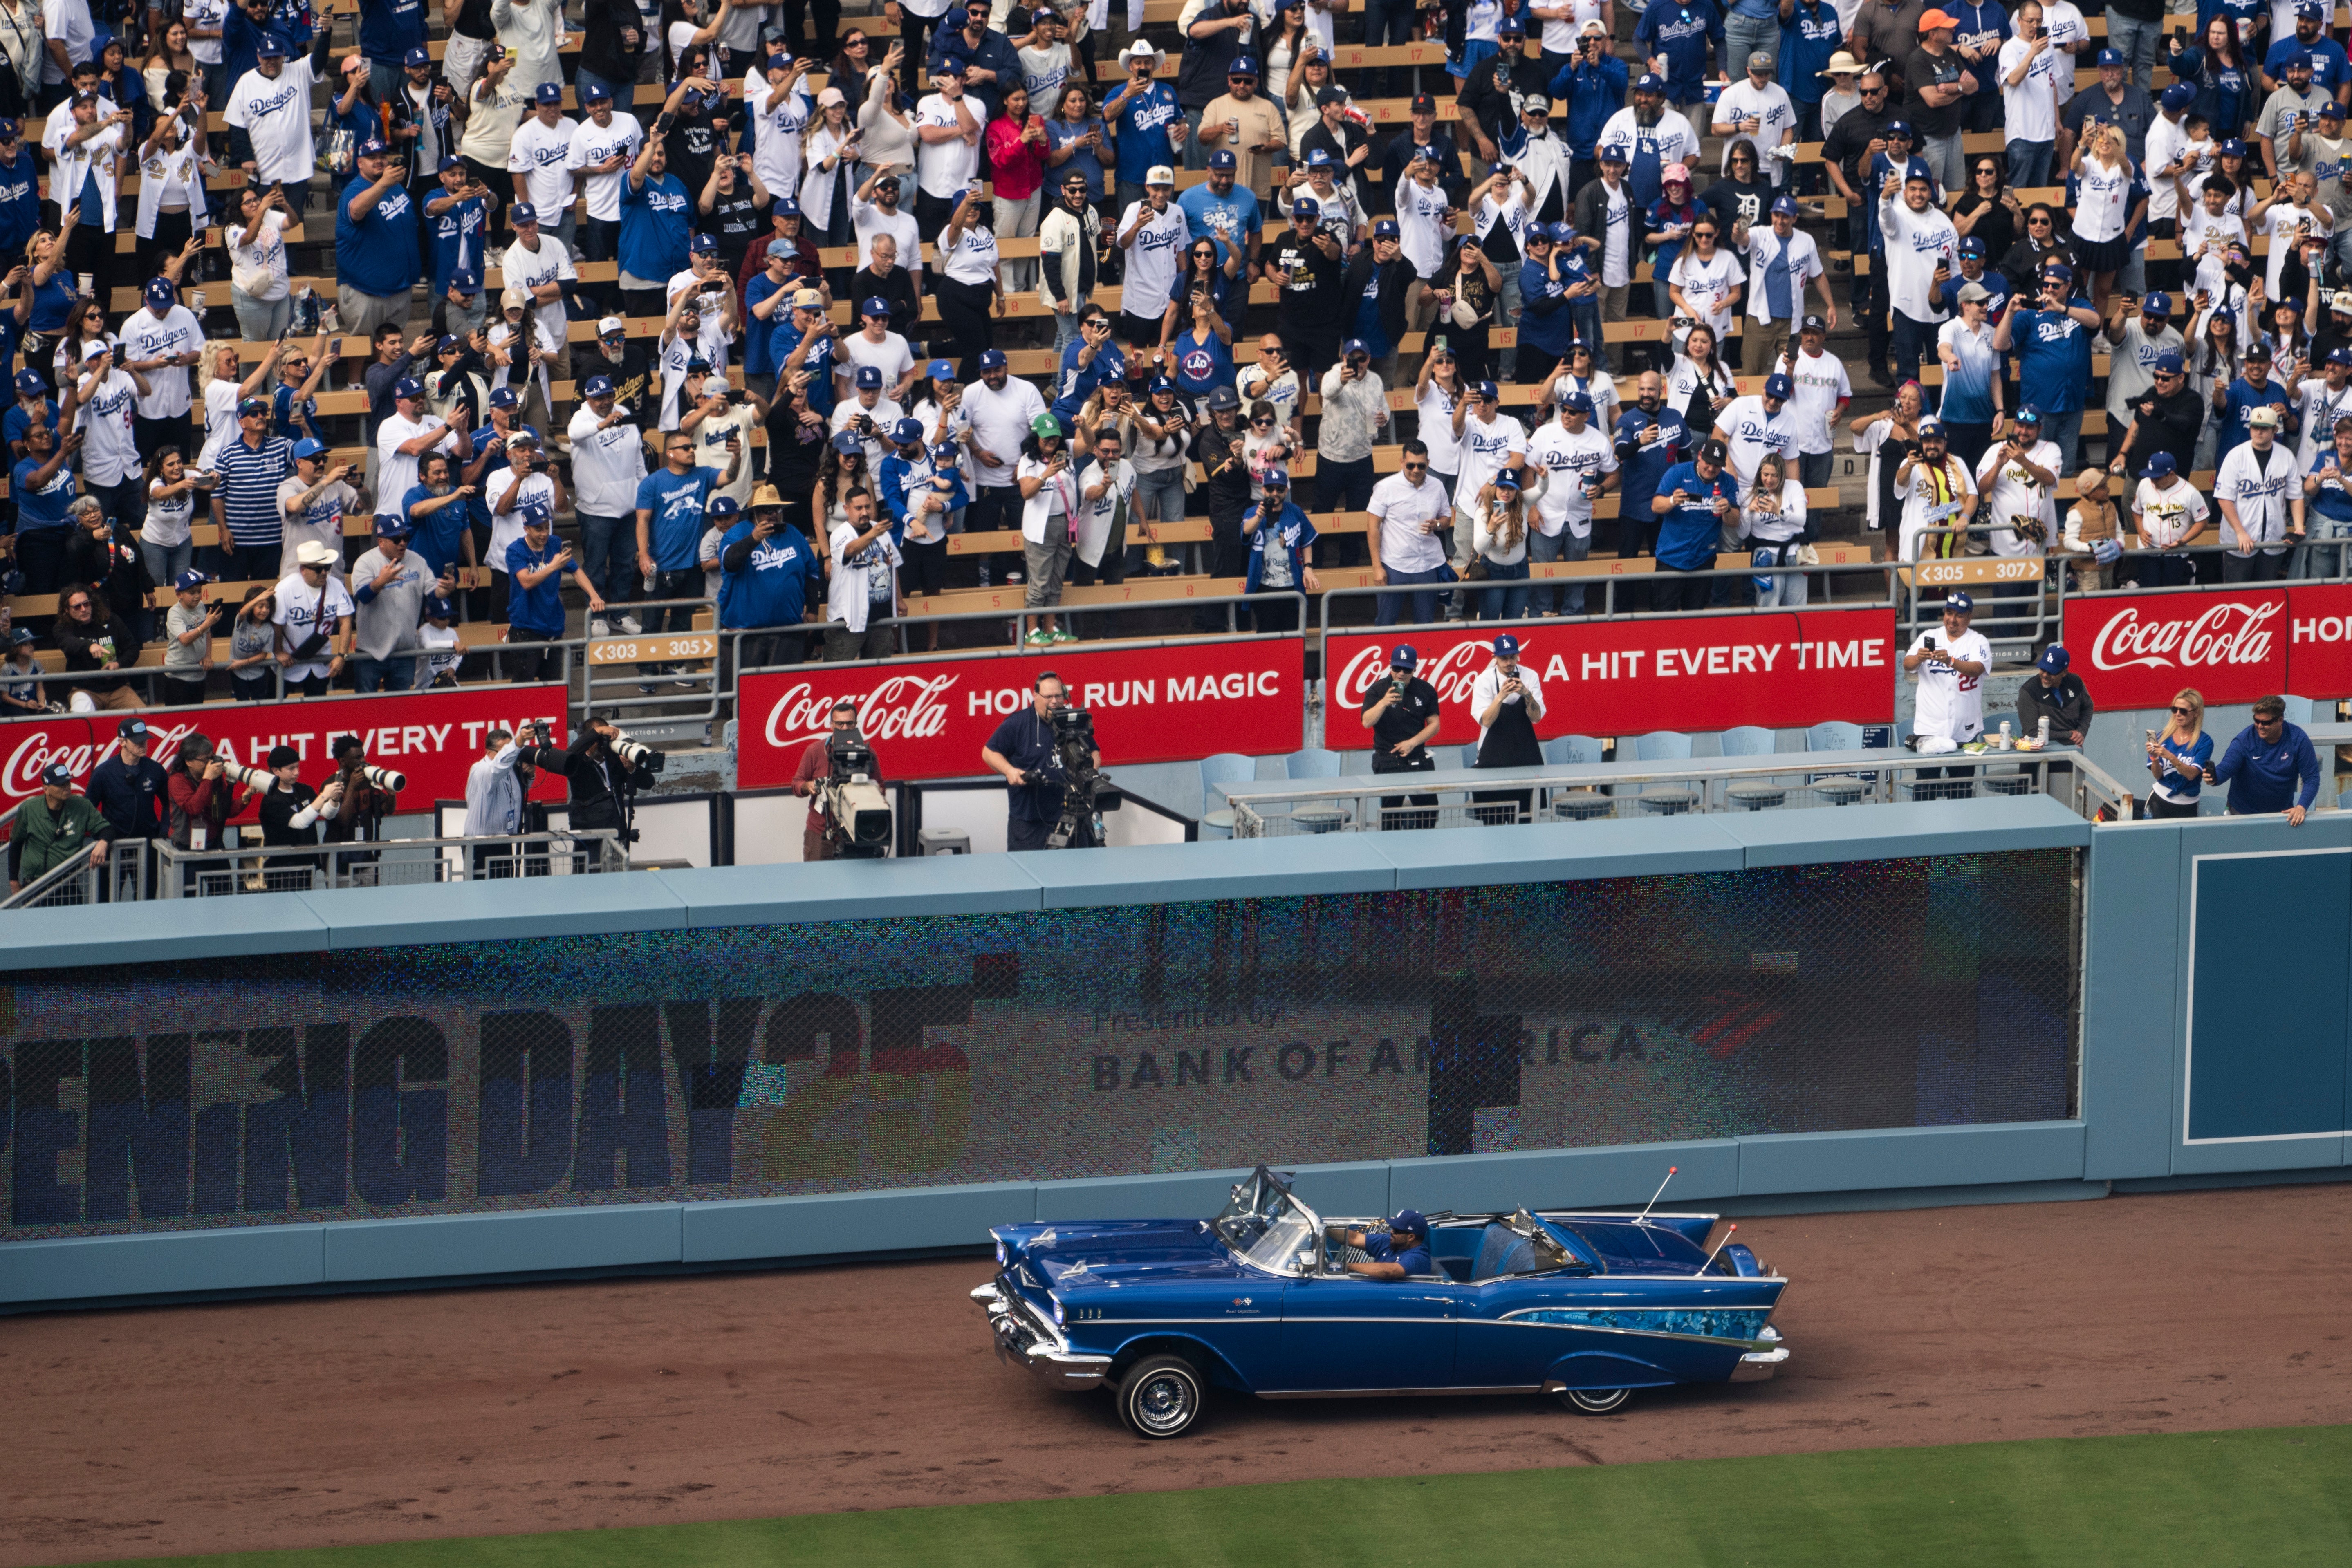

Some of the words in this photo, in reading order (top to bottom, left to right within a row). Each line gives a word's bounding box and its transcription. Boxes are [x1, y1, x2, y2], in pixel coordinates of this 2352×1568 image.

[879, 20, 888, 31] 9
[1958, 29, 2000, 49] Dodgers
[1352, 53, 1361, 63] 16
[1411, 50, 1422, 60] 17
[1096, 66, 1106, 77] 12
[1161, 63, 1171, 74] 13
[729, 84, 737, 94] 6
[250, 85, 297, 116] Dodgers
[1380, 108, 1390, 118] 16
[1445, 105, 1456, 116] 17
[103, 164, 114, 177] 5
[230, 174, 241, 185] 19
[2112, 194, 2118, 204] 11
[1203, 212, 1226, 227] SHO
[206, 233, 213, 244] 8
[1139, 228, 1180, 251] Dodgers
[1282, 249, 1298, 258] EAT
[2148, 245, 2155, 256] 5
[845, 251, 853, 262] 6
[578, 267, 585, 278] 2
[1012, 302, 1018, 312] 8
[641, 323, 648, 334] 2
[1635, 325, 1645, 336] 17
[141, 327, 188, 354] Dodgers
[1500, 332, 1511, 343] 15
[1045, 358, 1052, 370] 8
[1188, 359, 1207, 370] LAD
[1736, 381, 1747, 392] 18
[1794, 374, 1838, 388] MÉXICO
[1394, 396, 1404, 407] 13
[756, 432, 762, 442] 3
[848, 436, 854, 444] B
[1742, 421, 1789, 448] Dodgers
[1547, 452, 1601, 472] Dodgers
[1845, 459, 1854, 475] D
[2007, 466, 2028, 482] Rally
[67, 481, 74, 495] 17
[1923, 500, 1962, 523] Dodgers
[331, 516, 341, 534] 3
[1333, 517, 1340, 528] 11
[2171, 518, 2180, 529] 13
[1205, 526, 1212, 537] 9
[953, 540, 961, 550] 5
[1012, 536, 1019, 546] 6
[752, 547, 796, 571] Dodgers
[1836, 552, 1845, 563] 18
[1611, 564, 1622, 574] 15
[1933, 565, 1963, 581] 305
[1997, 562, 2026, 579] 307
[1238, 582, 1245, 592] 9
[1360, 576, 1367, 587] 11
[1124, 588, 1130, 599] 7
[1187, 585, 1193, 596] 8
[923, 601, 929, 612] 4
[993, 596, 1000, 607] 5
[2092, 601, 2285, 671] Coca-Cola
[607, 645, 637, 660] 303
[670, 640, 699, 656] 305
[1543, 655, 1570, 682] A
[1582, 650, 1645, 680] HIT
[1657, 643, 1783, 677] EVERY
[1791, 639, 1885, 670] TIME
[1959, 674, 1978, 691] 22
[1085, 679, 1155, 708] RUN
[1167, 670, 1280, 703] MAGIC
[217, 738, 240, 764] A
[251, 732, 314, 764] HIT
[1092, 1046, 1253, 1091] BANK
[1275, 1039, 1349, 1082] OF
[478, 997, 764, 1197] DAY
